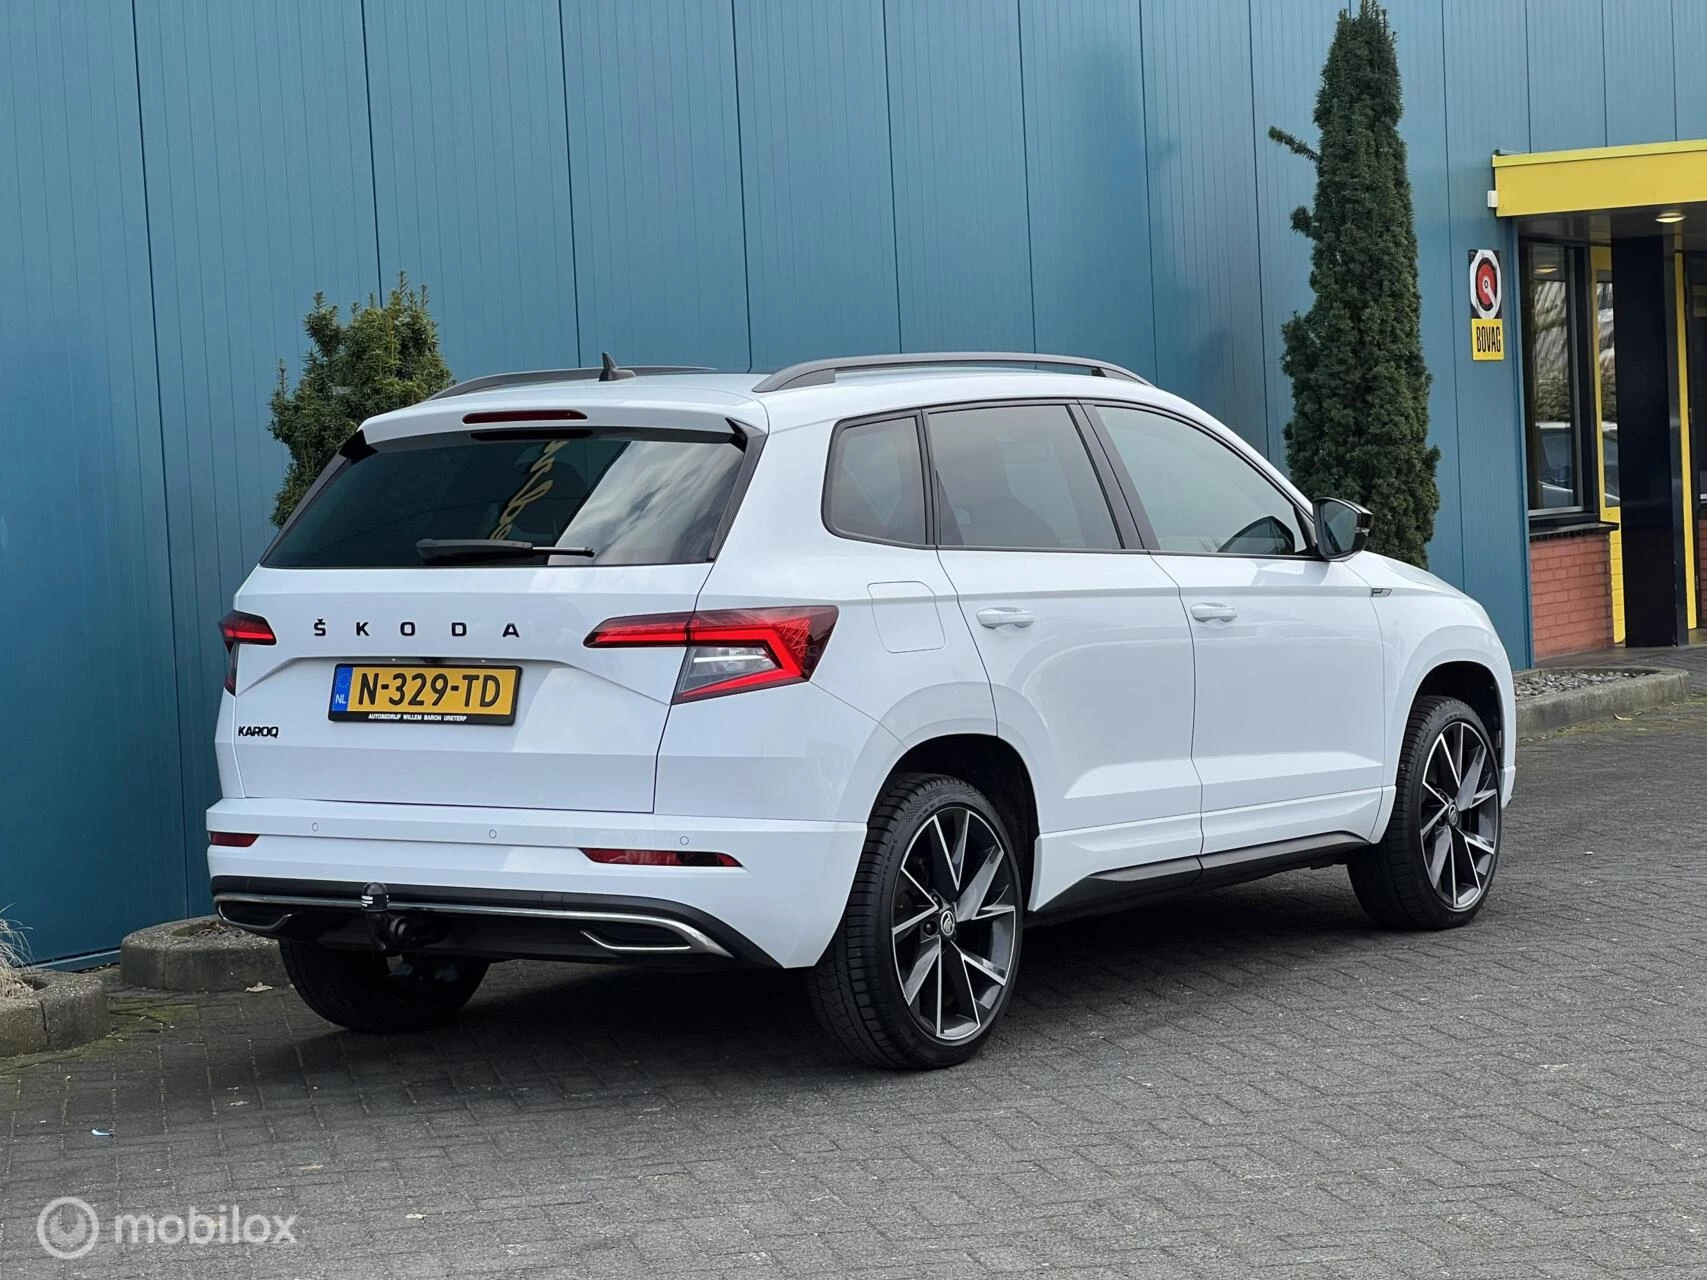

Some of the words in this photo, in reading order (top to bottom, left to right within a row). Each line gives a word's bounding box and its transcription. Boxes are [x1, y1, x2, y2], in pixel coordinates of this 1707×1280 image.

[1476, 326, 1501, 352] BOVAG
[313, 618, 520, 638] ŠKODA
[335, 694, 346, 704] NL
[358, 672, 501, 708] N-329-TD
[238, 726, 279, 738] KAROQ
